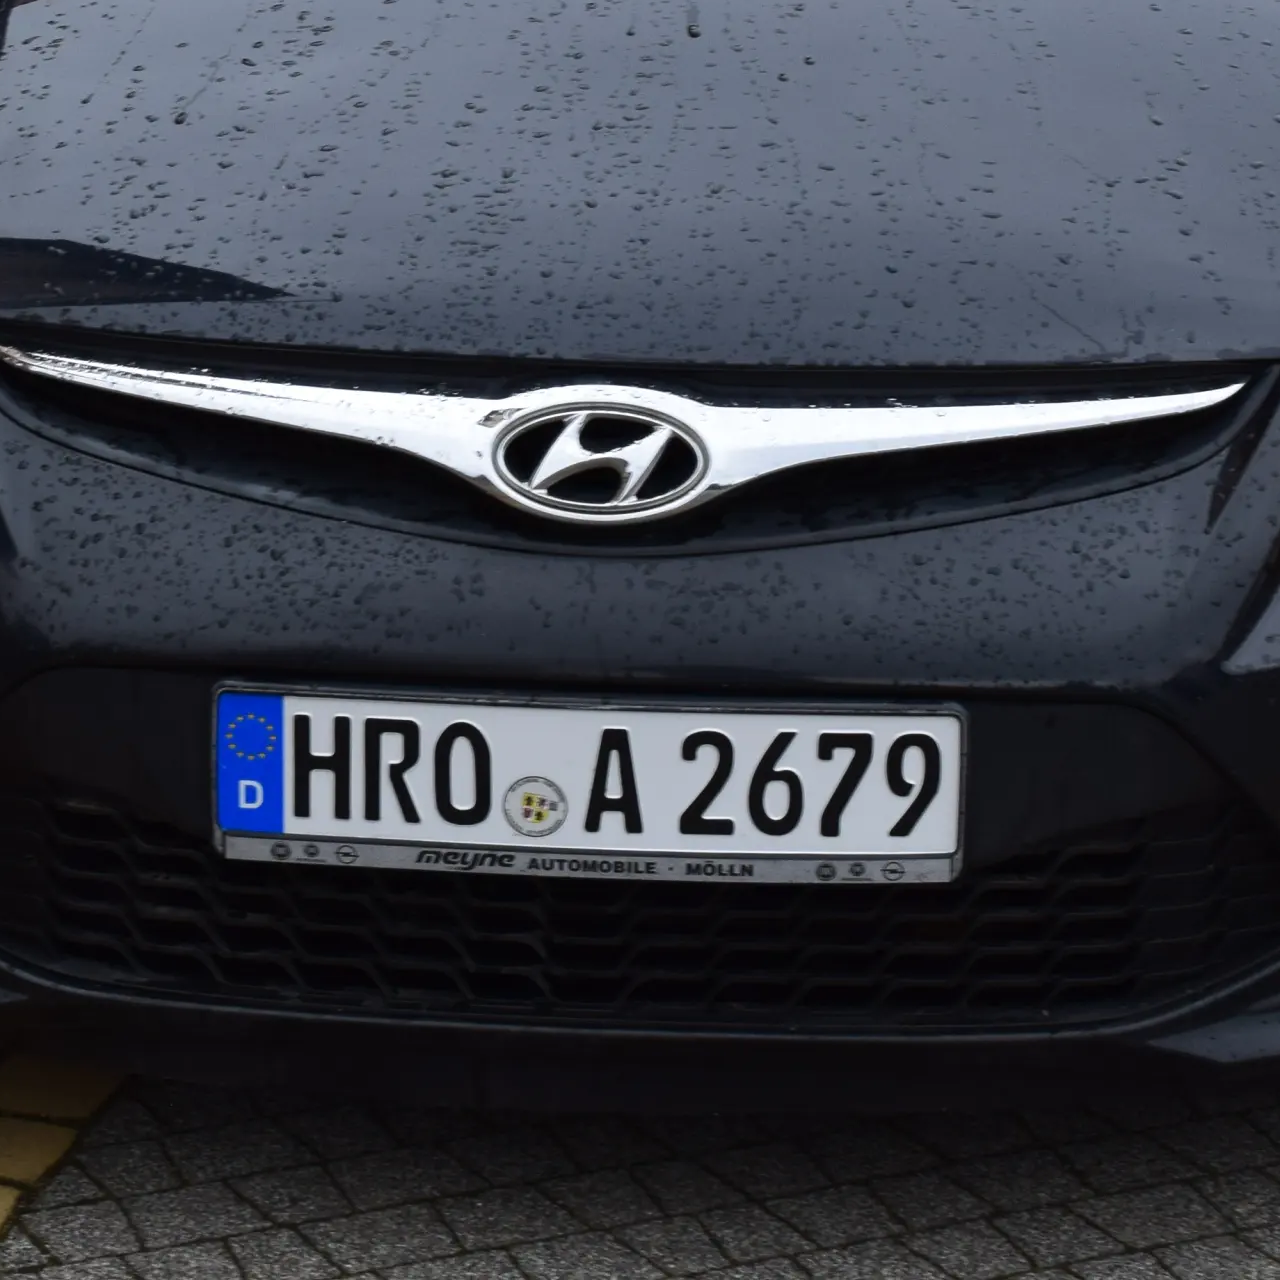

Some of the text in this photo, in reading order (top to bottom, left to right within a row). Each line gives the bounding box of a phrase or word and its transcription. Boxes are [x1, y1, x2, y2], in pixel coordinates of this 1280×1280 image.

[292, 713, 493, 827] HRO
[584, 727, 643, 835] A
[679, 729, 942, 839] 2679
[238, 779, 263, 810] D
[416, 849, 754, 878] meyne AUTOMOBILE MÖLLN
